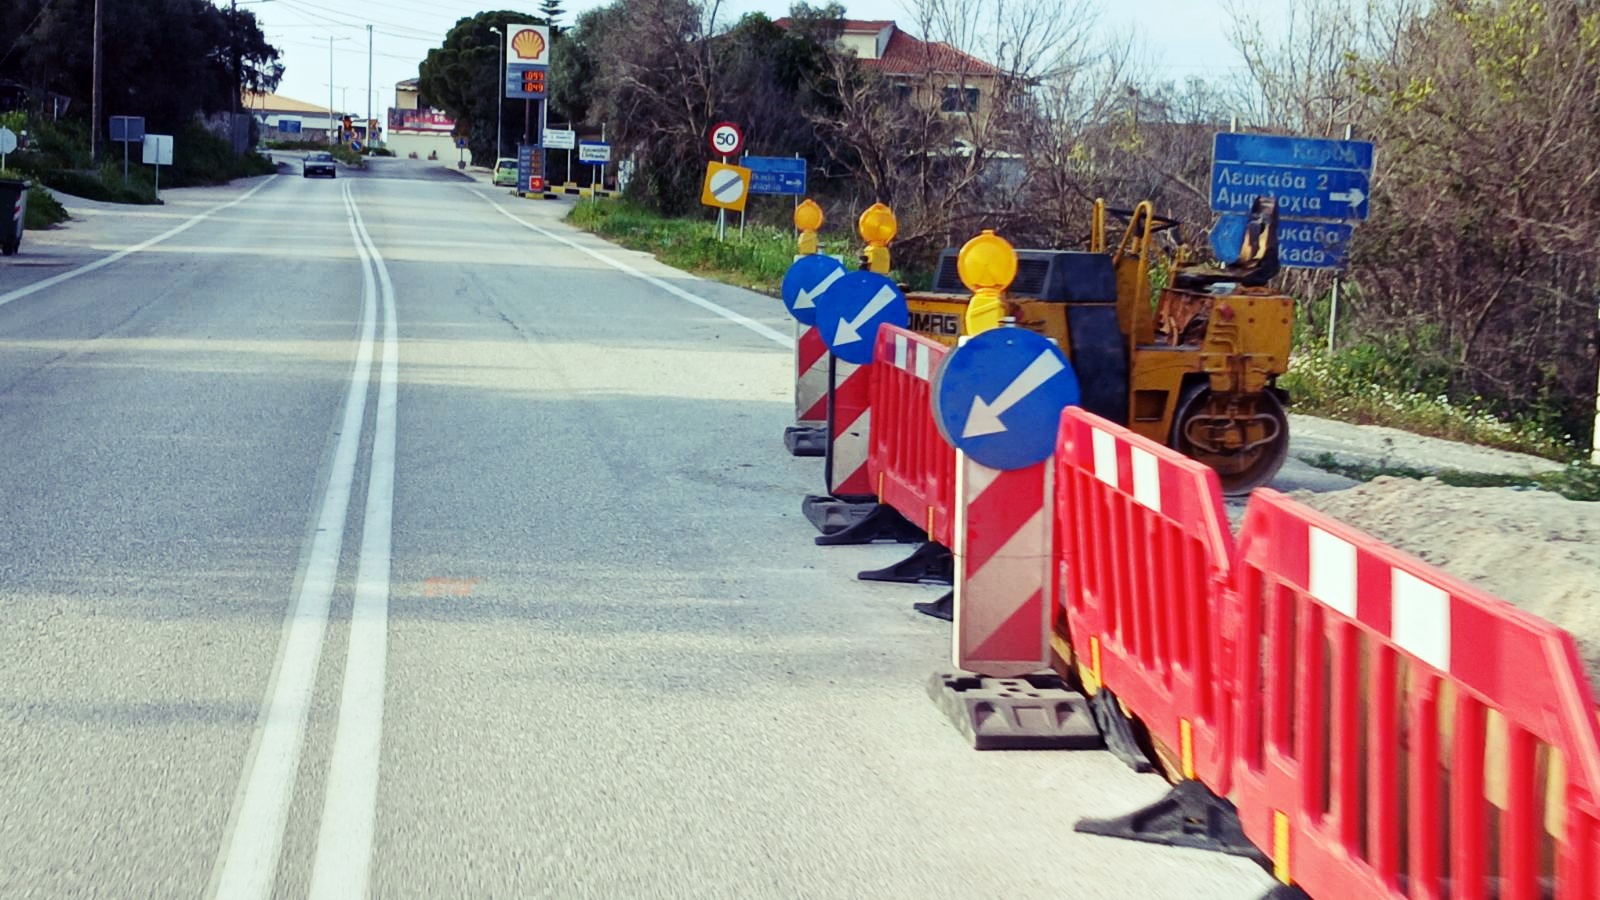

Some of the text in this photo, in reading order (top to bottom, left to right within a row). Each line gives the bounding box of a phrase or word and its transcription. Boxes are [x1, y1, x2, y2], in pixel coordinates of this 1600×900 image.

[716, 133, 736, 146] 50
[1217, 167, 1329, 190] Λευκάδα 2
[1216, 187, 1321, 213] Αμφοχία
[1277, 225, 1340, 244] υκάδα
[1278, 244, 1325, 263] kada
[907, 312, 958, 334] MAG
